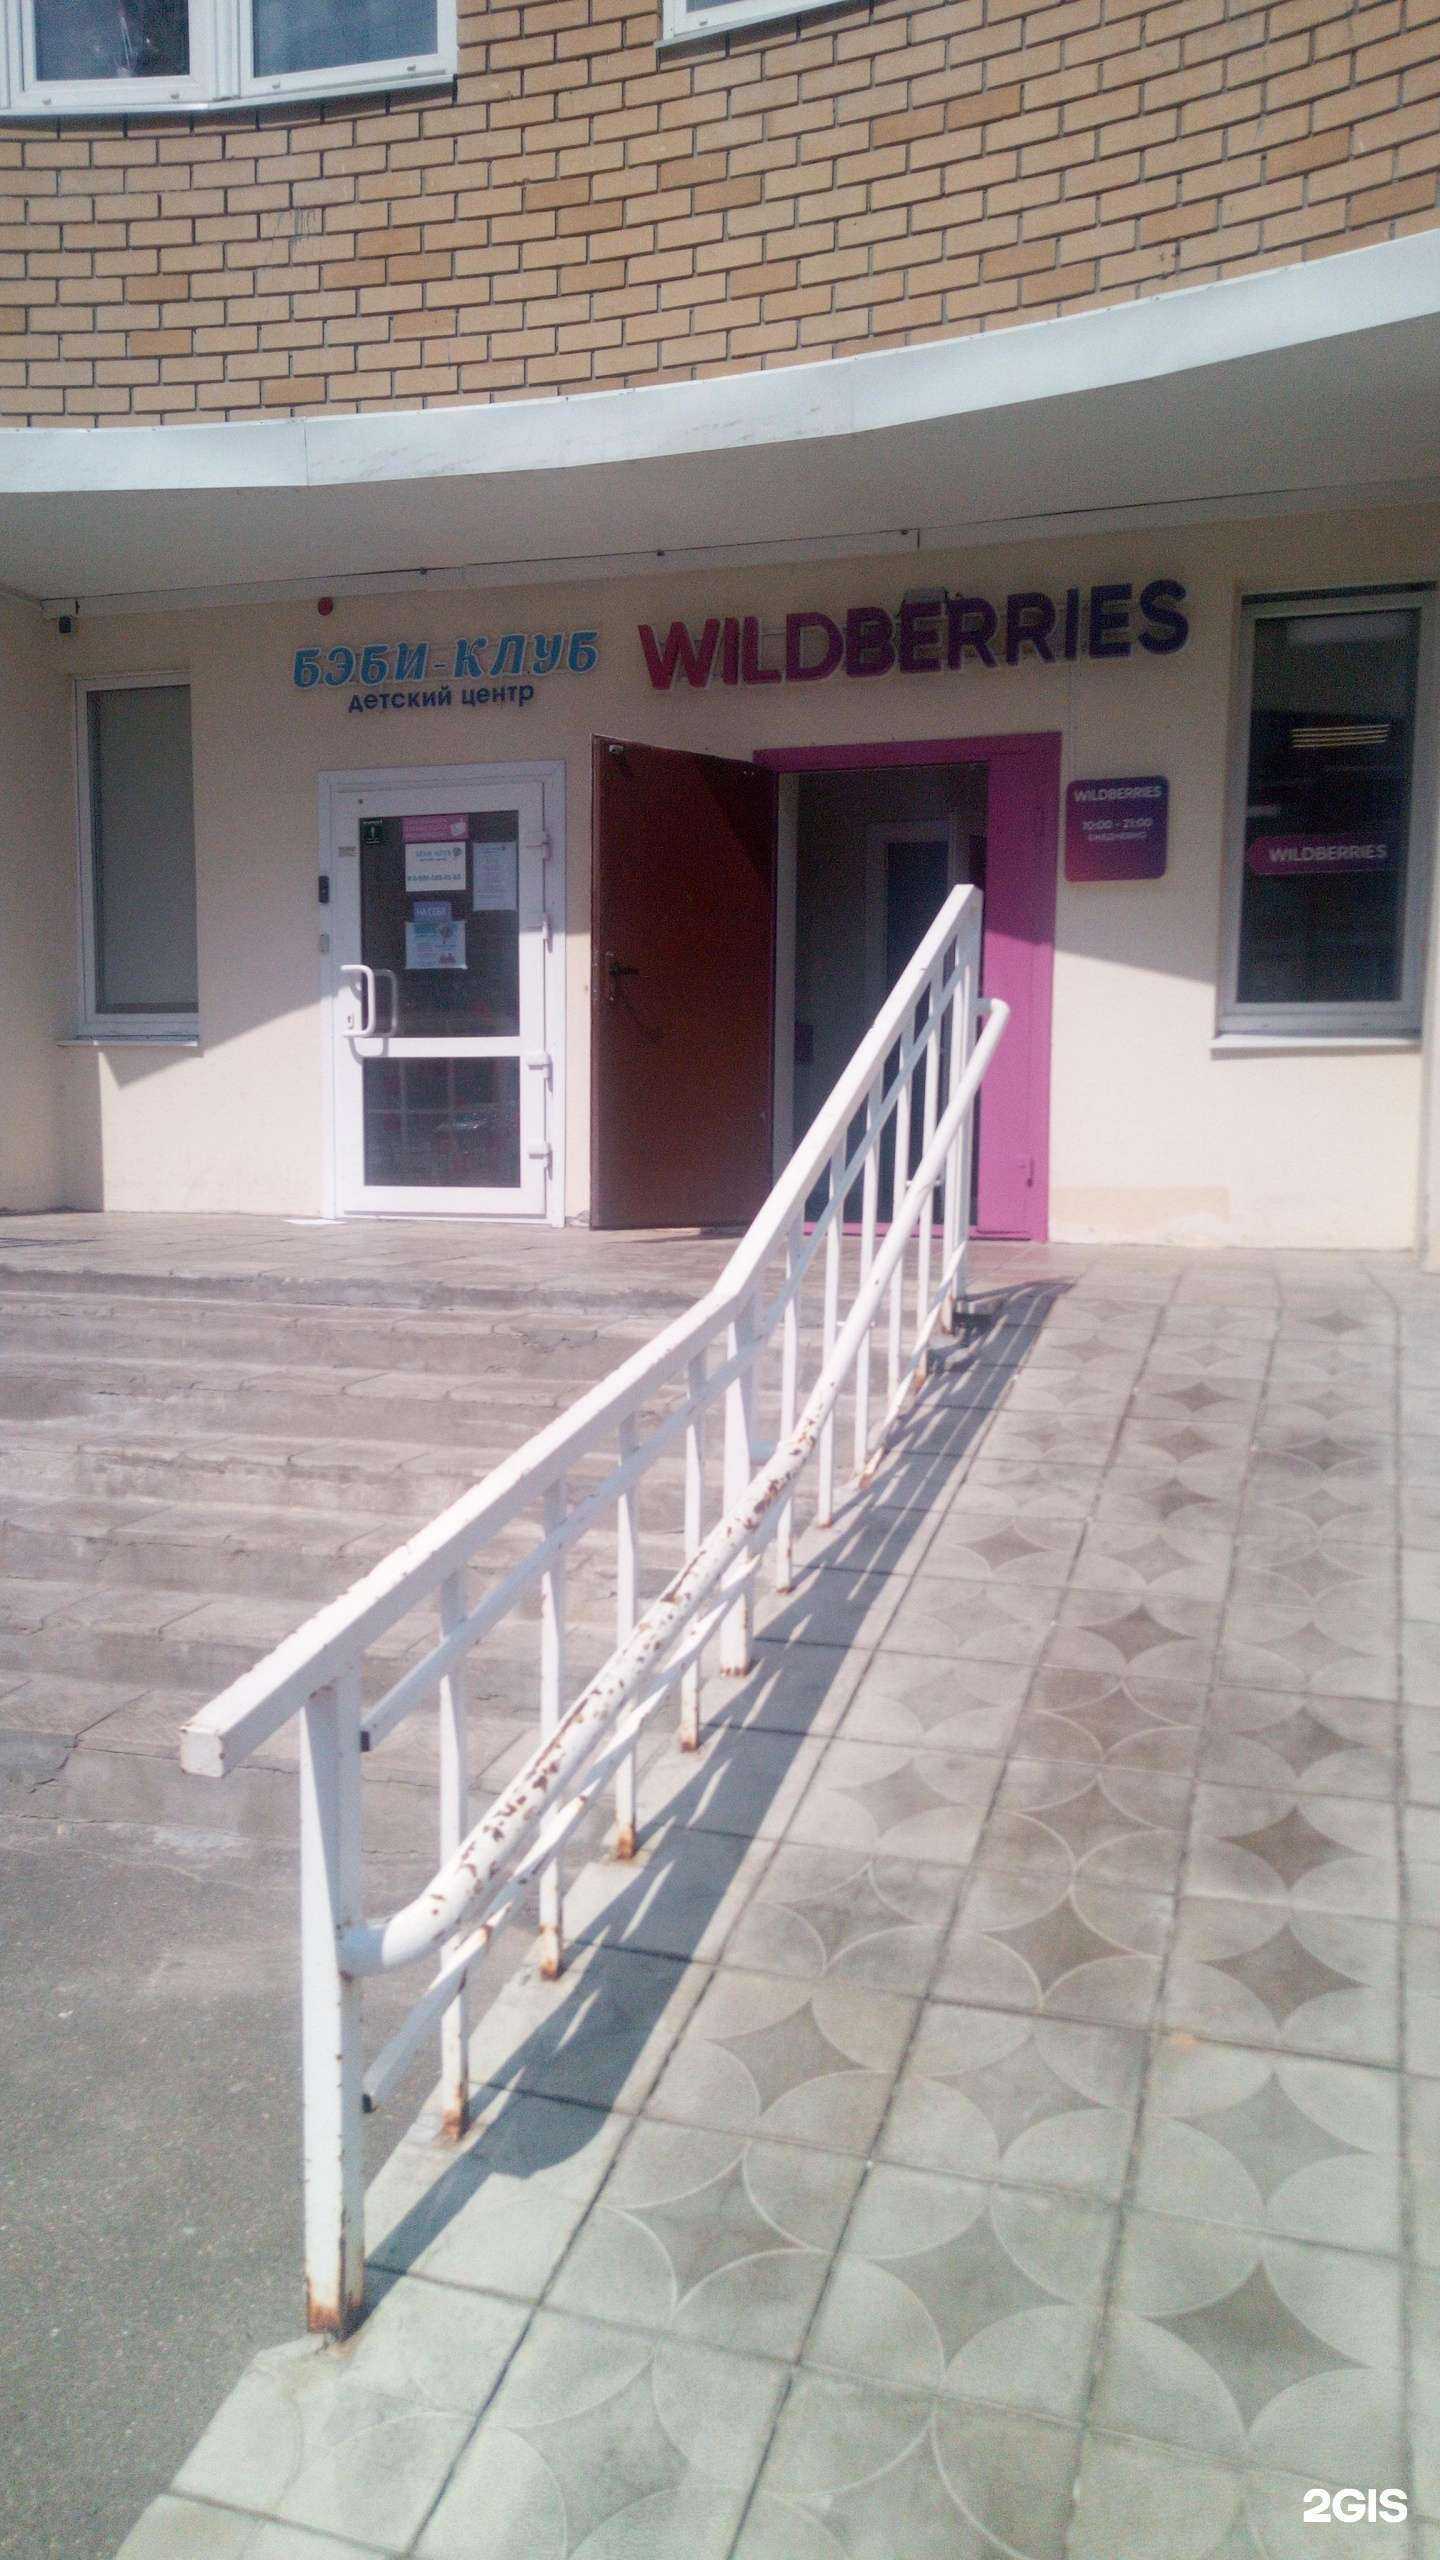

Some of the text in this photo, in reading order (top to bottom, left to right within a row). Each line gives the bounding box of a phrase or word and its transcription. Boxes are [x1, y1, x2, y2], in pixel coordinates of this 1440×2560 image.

[637, 579, 1191, 691] WILDBERRIES
[293, 630, 599, 688] БЭБИ-КЛУБ
[348, 684, 534, 713] детский центр
[1074, 786, 1162, 802] WILDBERRIES
[1269, 844, 1388, 863] WILDBERRIES
